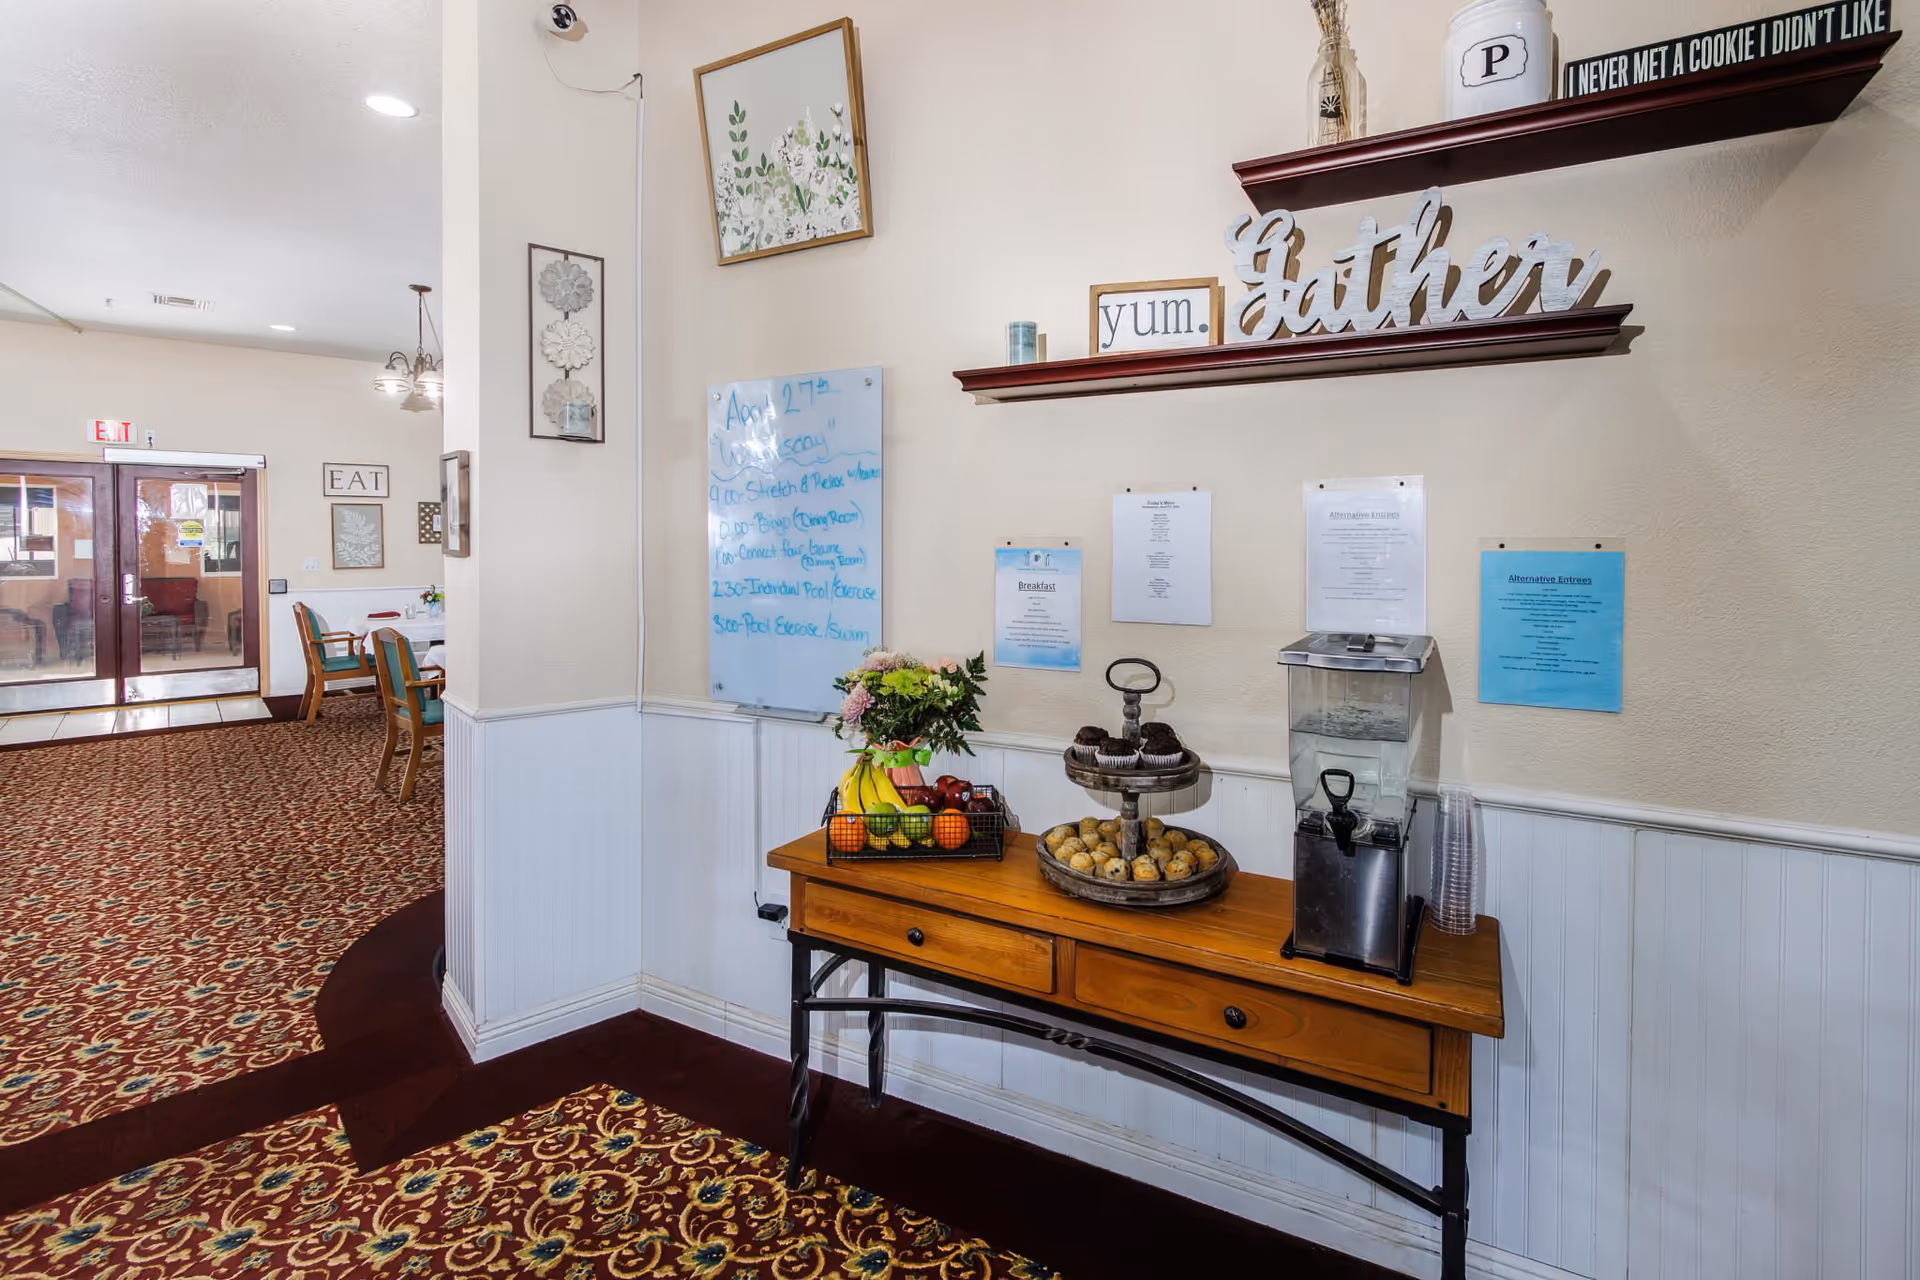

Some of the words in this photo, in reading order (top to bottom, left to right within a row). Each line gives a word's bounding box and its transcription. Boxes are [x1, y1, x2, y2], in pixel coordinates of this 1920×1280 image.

[1568, 66, 1575, 98] I
[1578, 56, 1629, 96] NEVER
[1633, 47, 1668, 86] MET
[1672, 43, 1684, 76] A
[1689, 25, 1755, 73] COOKIE
[1760, 24, 1766, 58] I
[1772, 7, 1836, 56] DIDN'T
[1840, 0, 1886, 40] LIKE
[1481, 44, 1510, 79] P
[1224, 186, 1602, 342] Gather
[1098, 296, 1210, 351] yum.
[95, 420, 131, 442] EIT
[329, 470, 384, 491] EAT
[1329, 511, 1369, 520] Alternative
[1018, 581, 1056, 591] Breakfast
[1508, 574, 1557, 584] Alternative
[1558, 576, 1592, 585] Entrees
